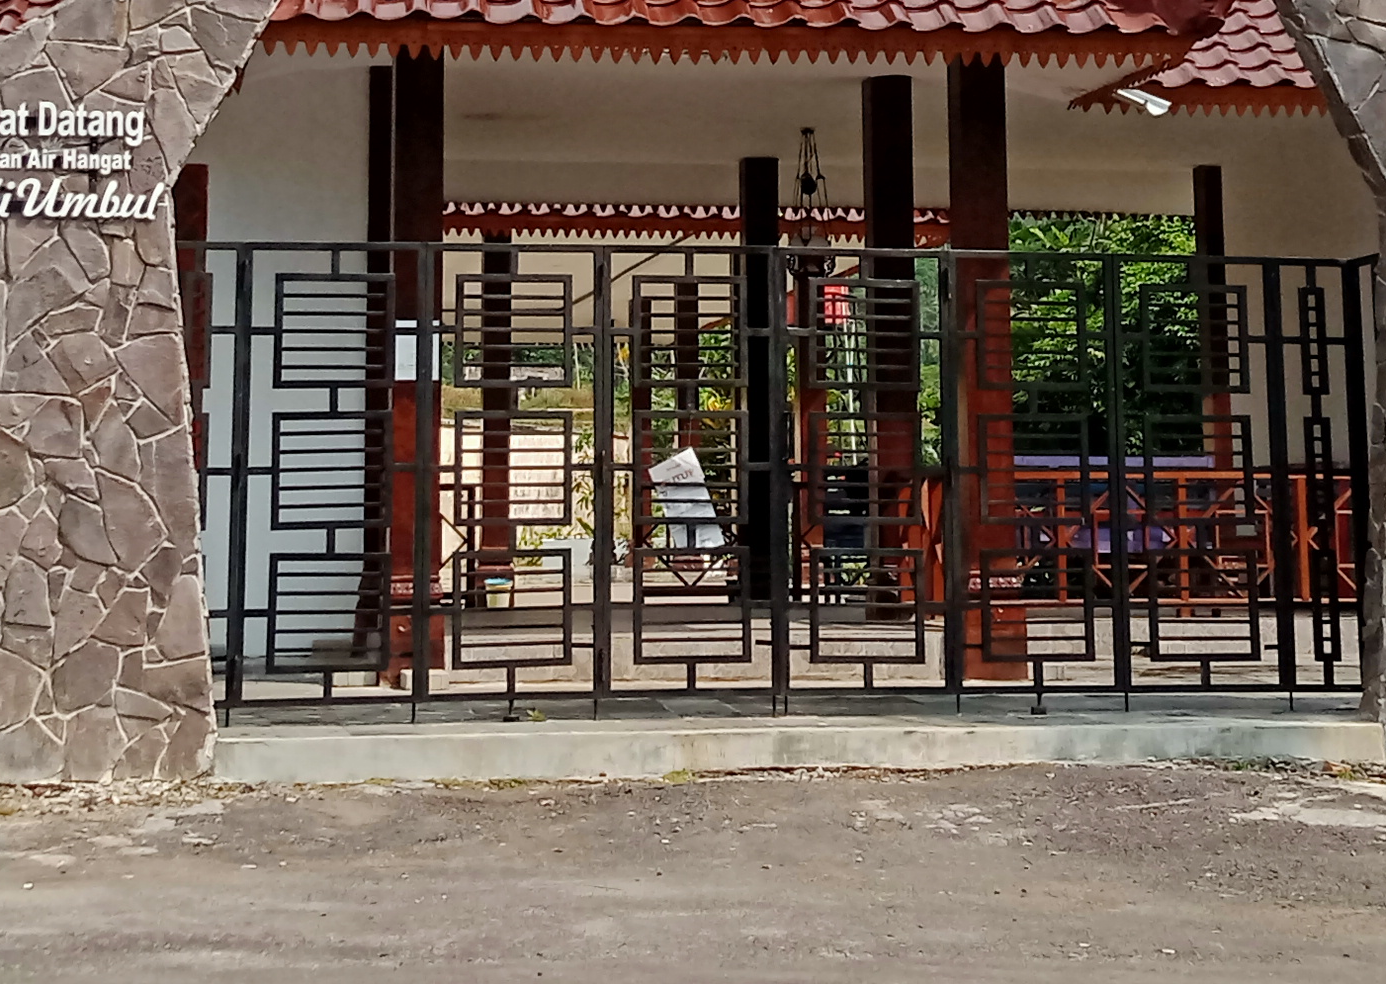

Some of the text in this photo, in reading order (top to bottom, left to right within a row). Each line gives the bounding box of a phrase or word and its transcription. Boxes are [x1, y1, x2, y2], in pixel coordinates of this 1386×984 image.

[38, 102, 145, 147] Datang
[28, 150, 57, 170] Air
[63, 151, 132, 175] Hangat
[17, 177, 166, 221] Umbul
